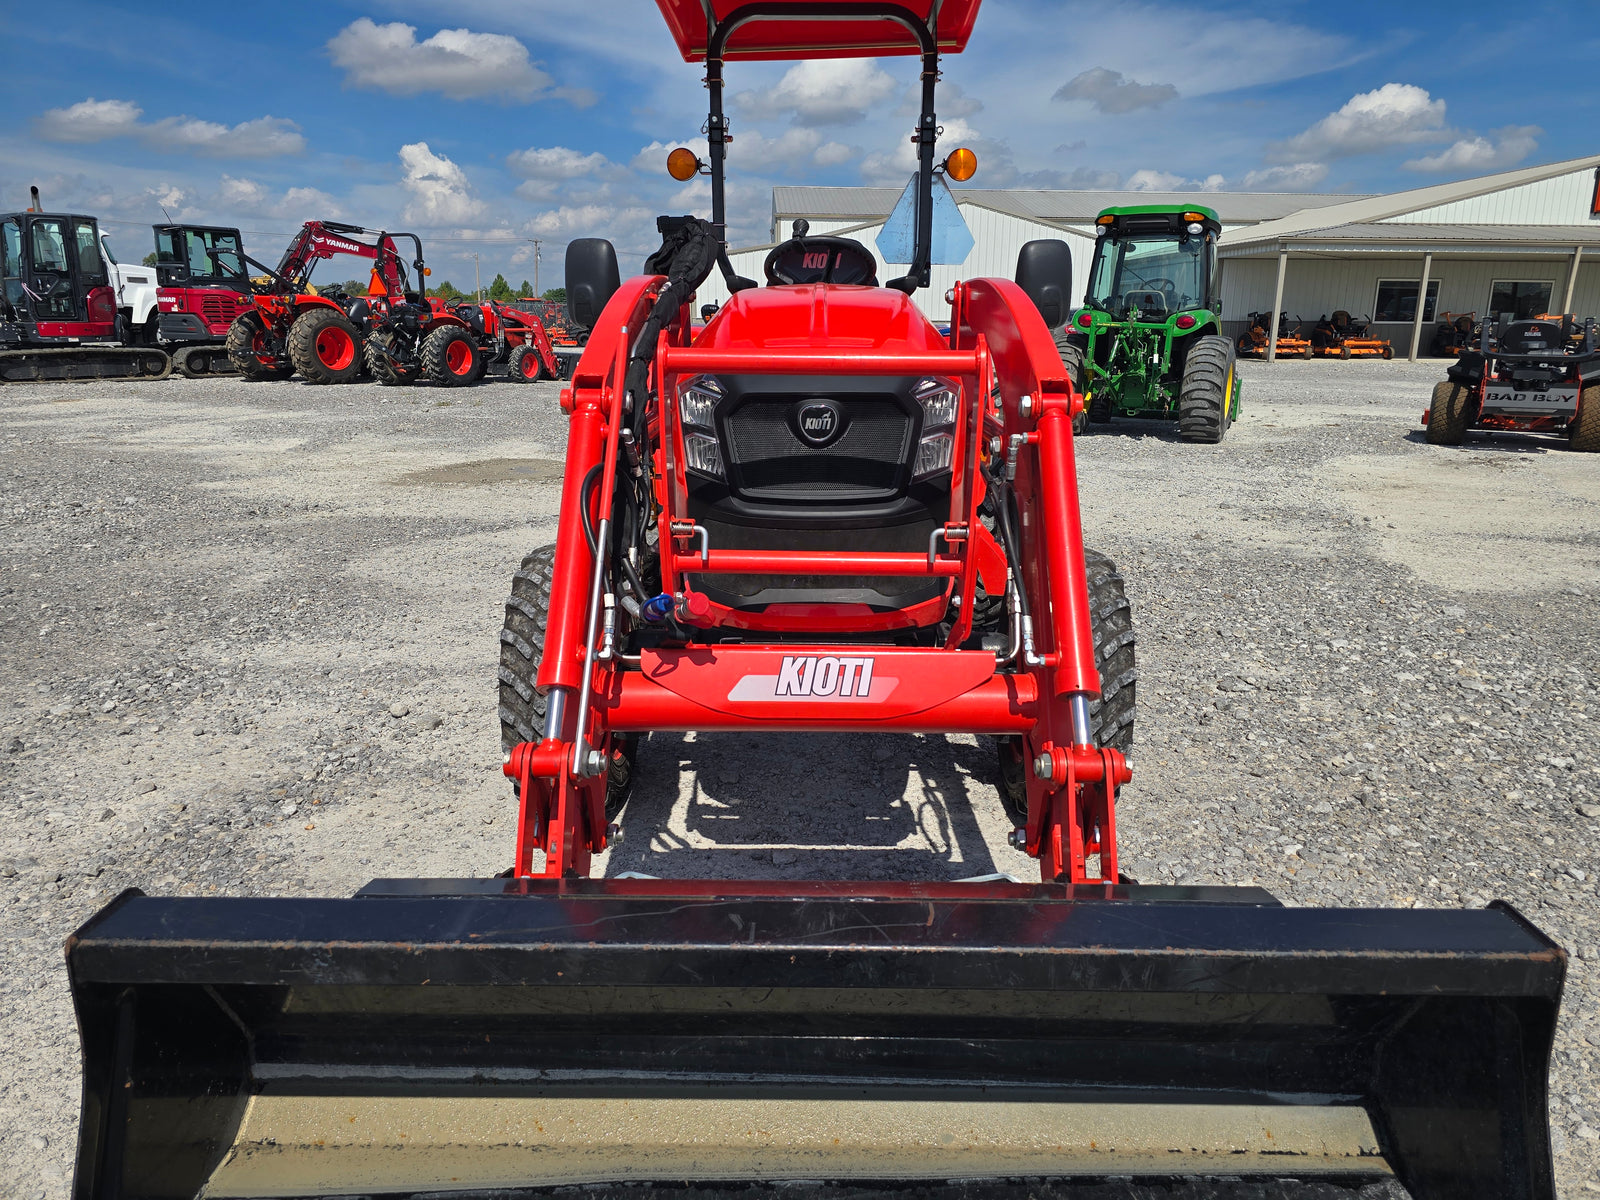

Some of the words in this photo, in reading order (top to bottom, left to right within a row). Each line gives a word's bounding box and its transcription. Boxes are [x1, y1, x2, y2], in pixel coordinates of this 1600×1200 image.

[325, 238, 360, 252] YANMAR
[802, 252, 842, 269] KIOI
[1486, 392, 1527, 402] BAD
[1532, 393, 1575, 403] BOY
[804, 414, 832, 430] KIOTI
[775, 655, 875, 697] KIOTI
